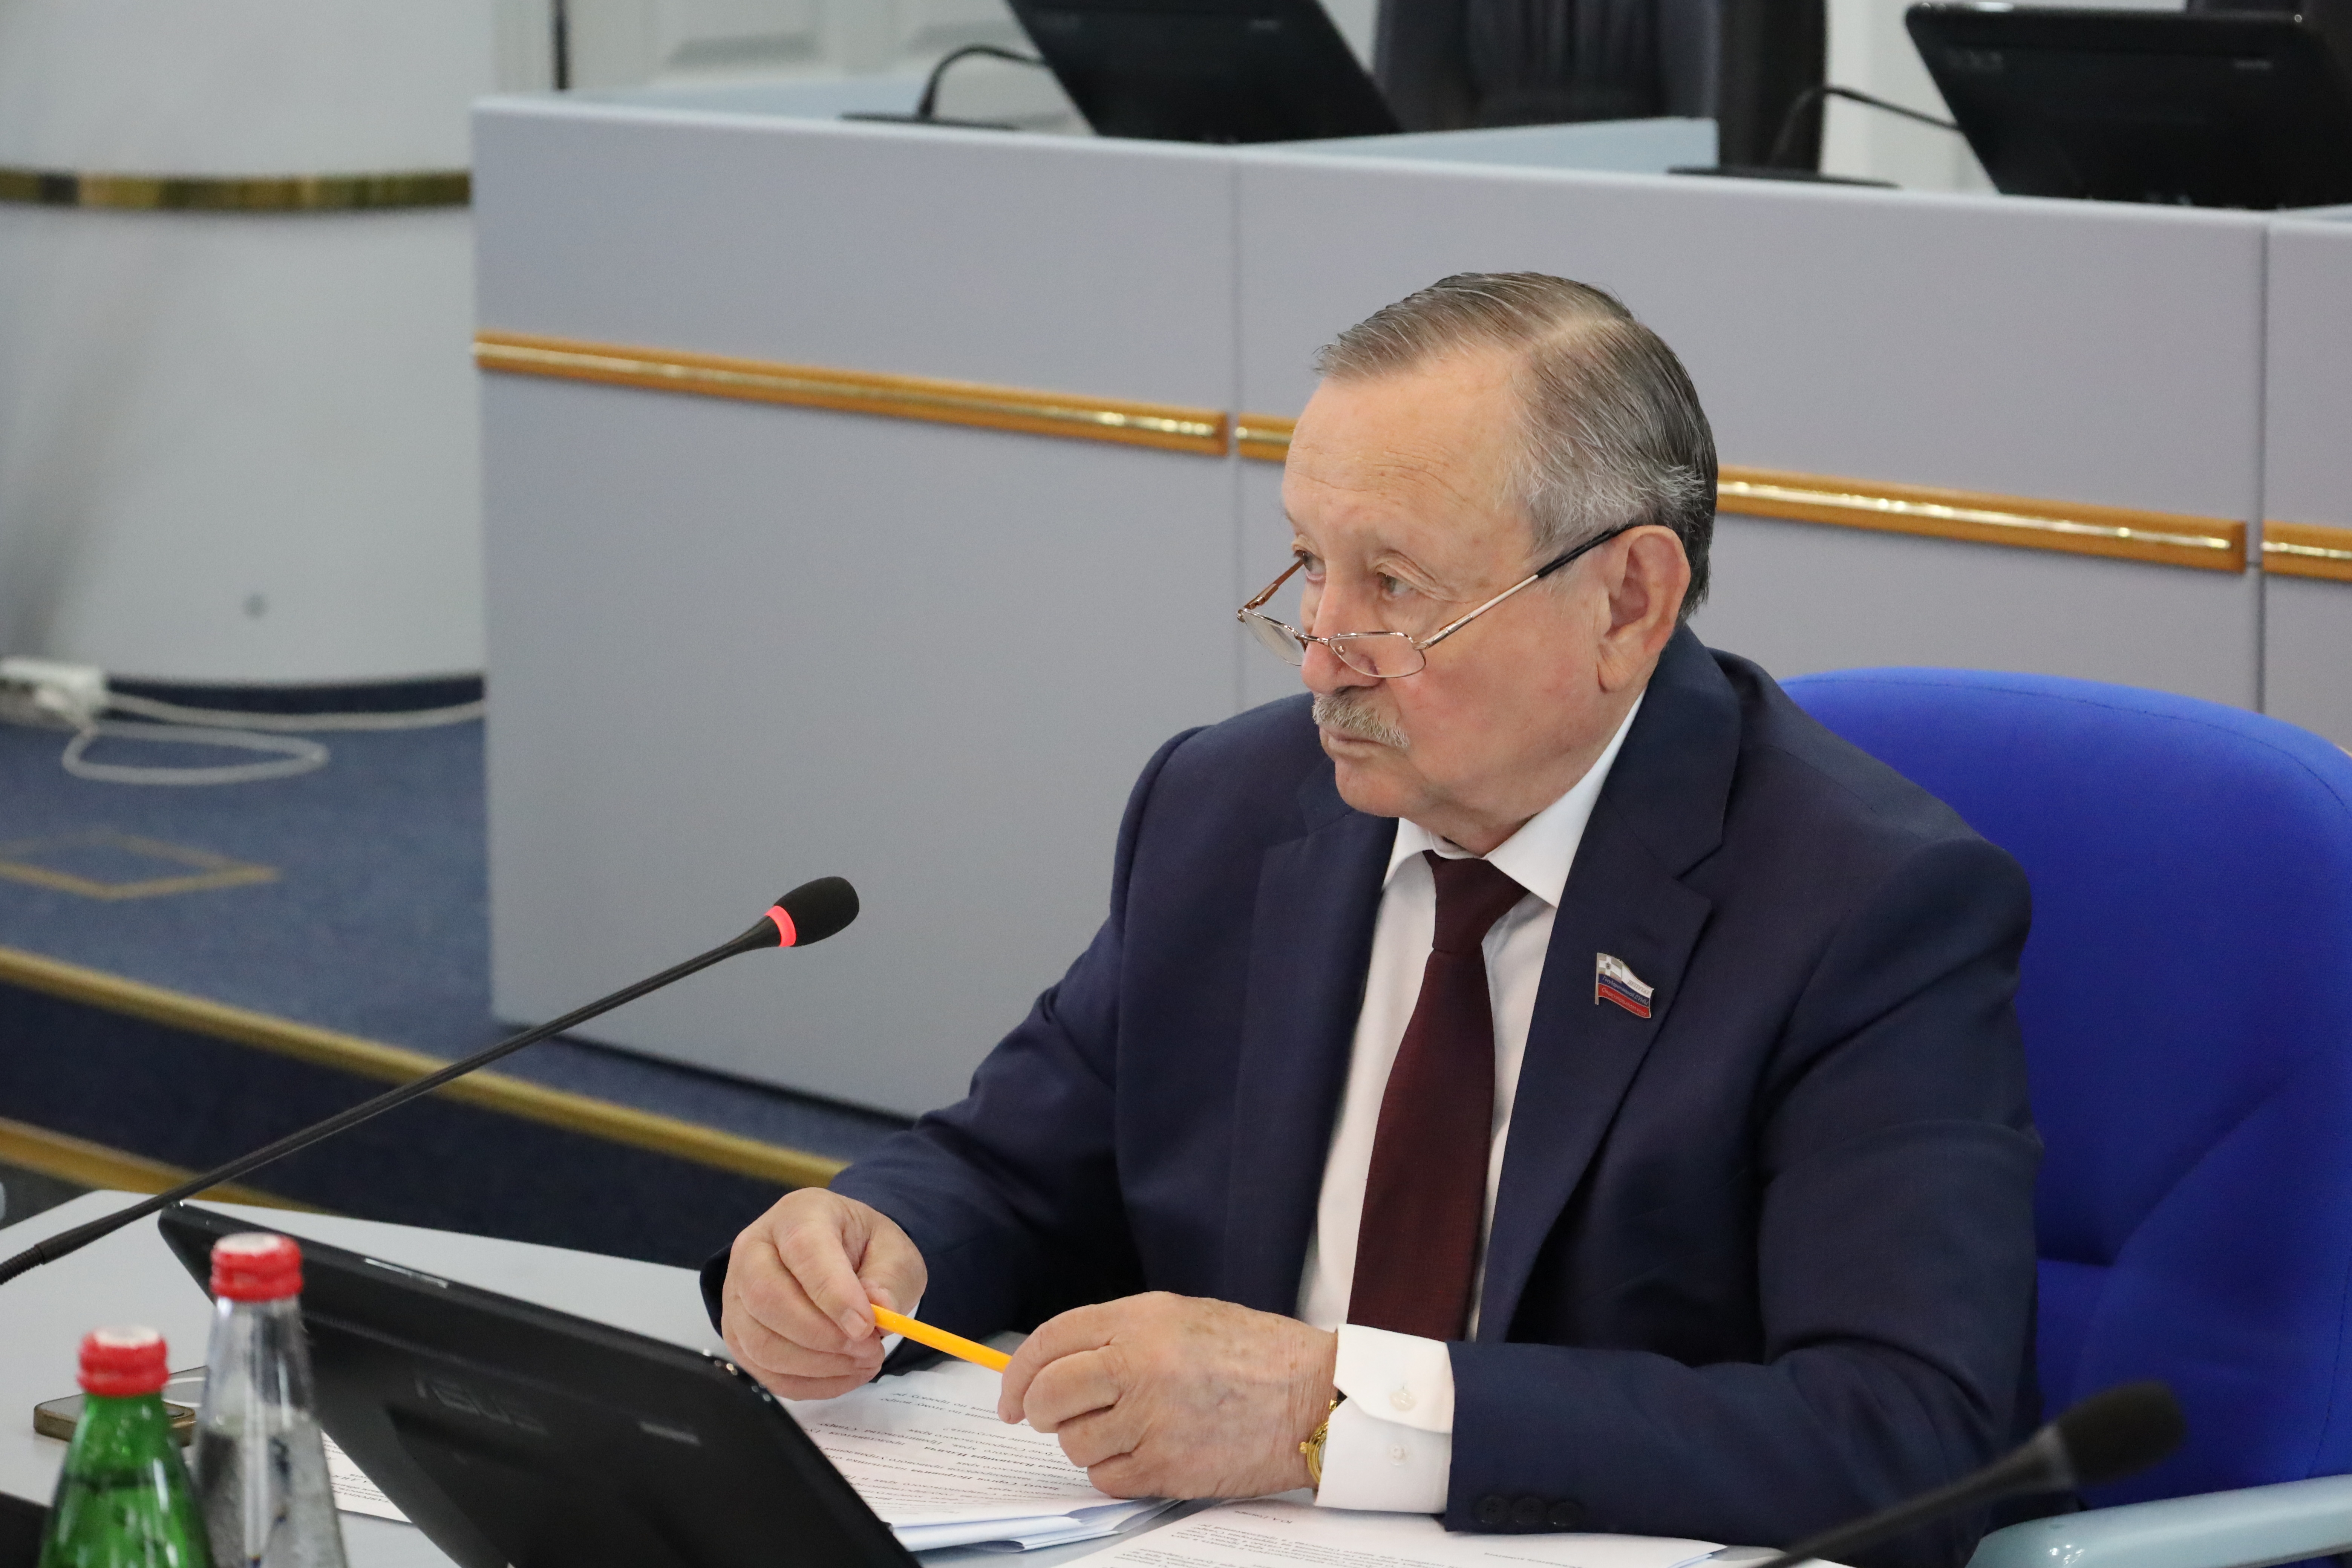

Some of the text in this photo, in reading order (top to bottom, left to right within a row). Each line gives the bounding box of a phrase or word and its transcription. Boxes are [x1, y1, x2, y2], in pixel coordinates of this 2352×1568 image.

[1628, 980, 1651, 995] ДЕПУТАТ
[1634, 992, 1649, 1005] ДУМЫ
[911, 1395, 950, 1404] проекту
[828, 1431, 905, 1446] представителя
[864, 1429, 943, 1445] Правительства
[934, 1434, 1026, 1451] Ставропольского
[943, 1428, 1053, 1447] желание выступить?
[924, 1447, 968, 1457] Ильича
[820, 1447, 1096, 1488] кспертизы законопроектов правового управления
[845, 1458, 907, 1470] начальника
[971, 1455, 1034, 1467] Владимира
[911, 1469, 972, 1479] Петровича
